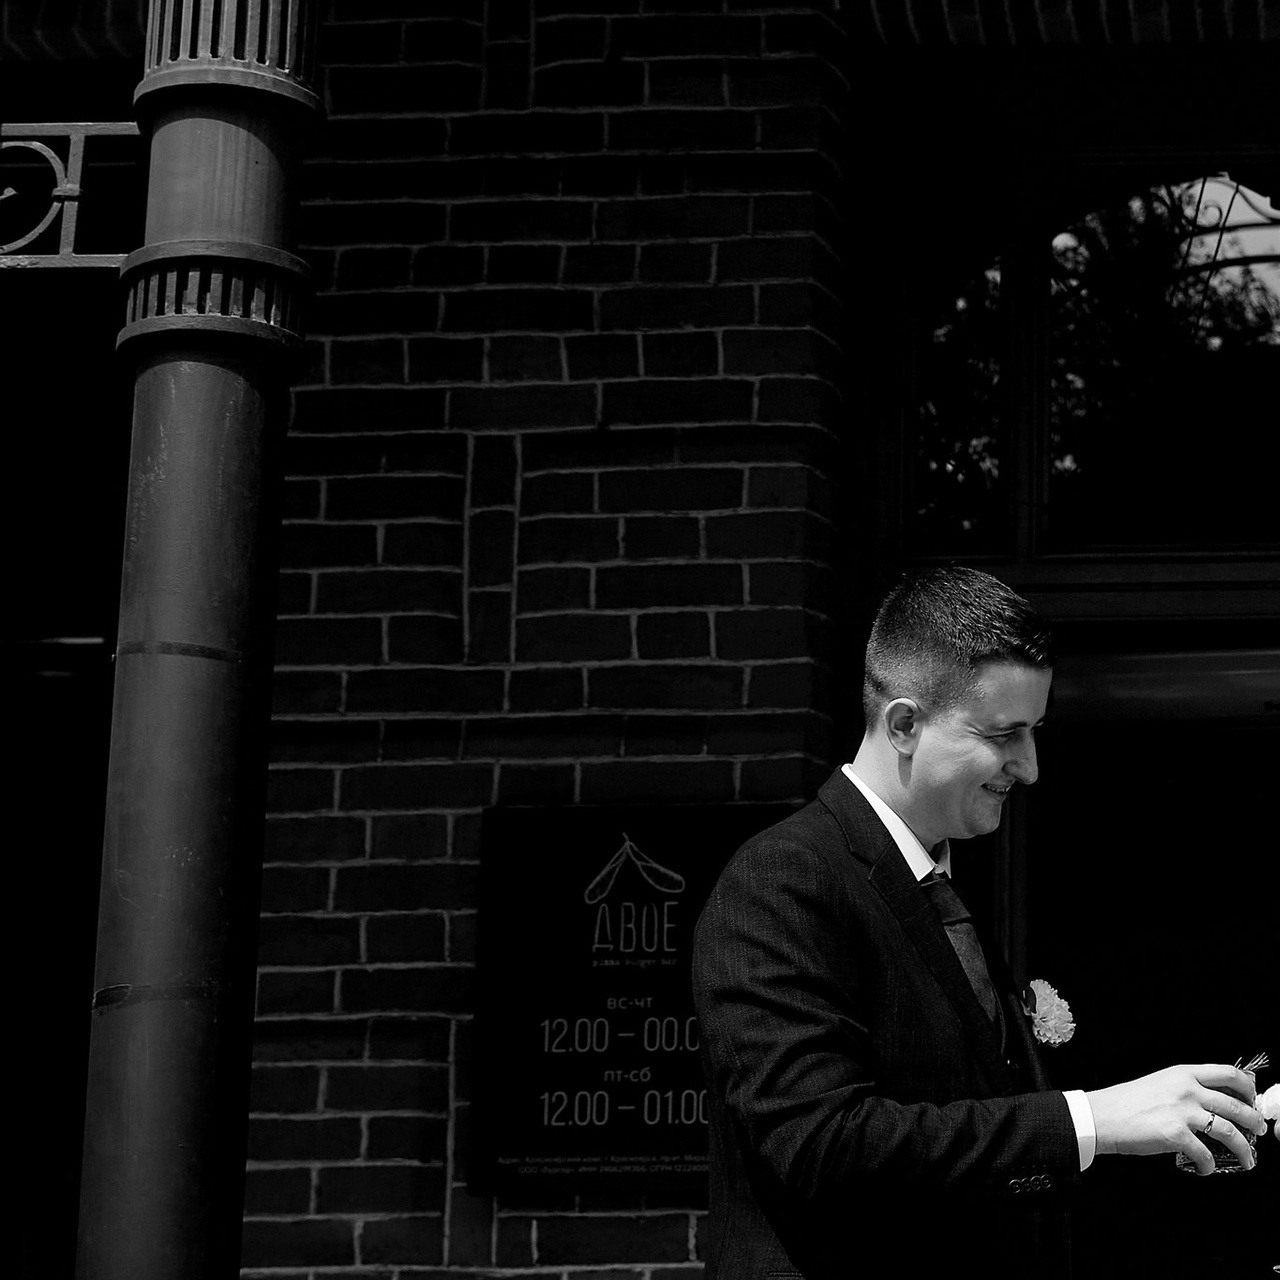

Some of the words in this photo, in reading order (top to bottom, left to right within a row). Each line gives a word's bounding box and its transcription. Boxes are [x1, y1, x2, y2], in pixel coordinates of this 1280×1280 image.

[592, 901, 679, 953] ДВОЕ
[539, 1018, 609, 1053] 12.00
[644, 1017, 700, 1052] 00.0
[603, 1066, 651, 1082] пт-сб
[539, 1091, 609, 1126] 12.00
